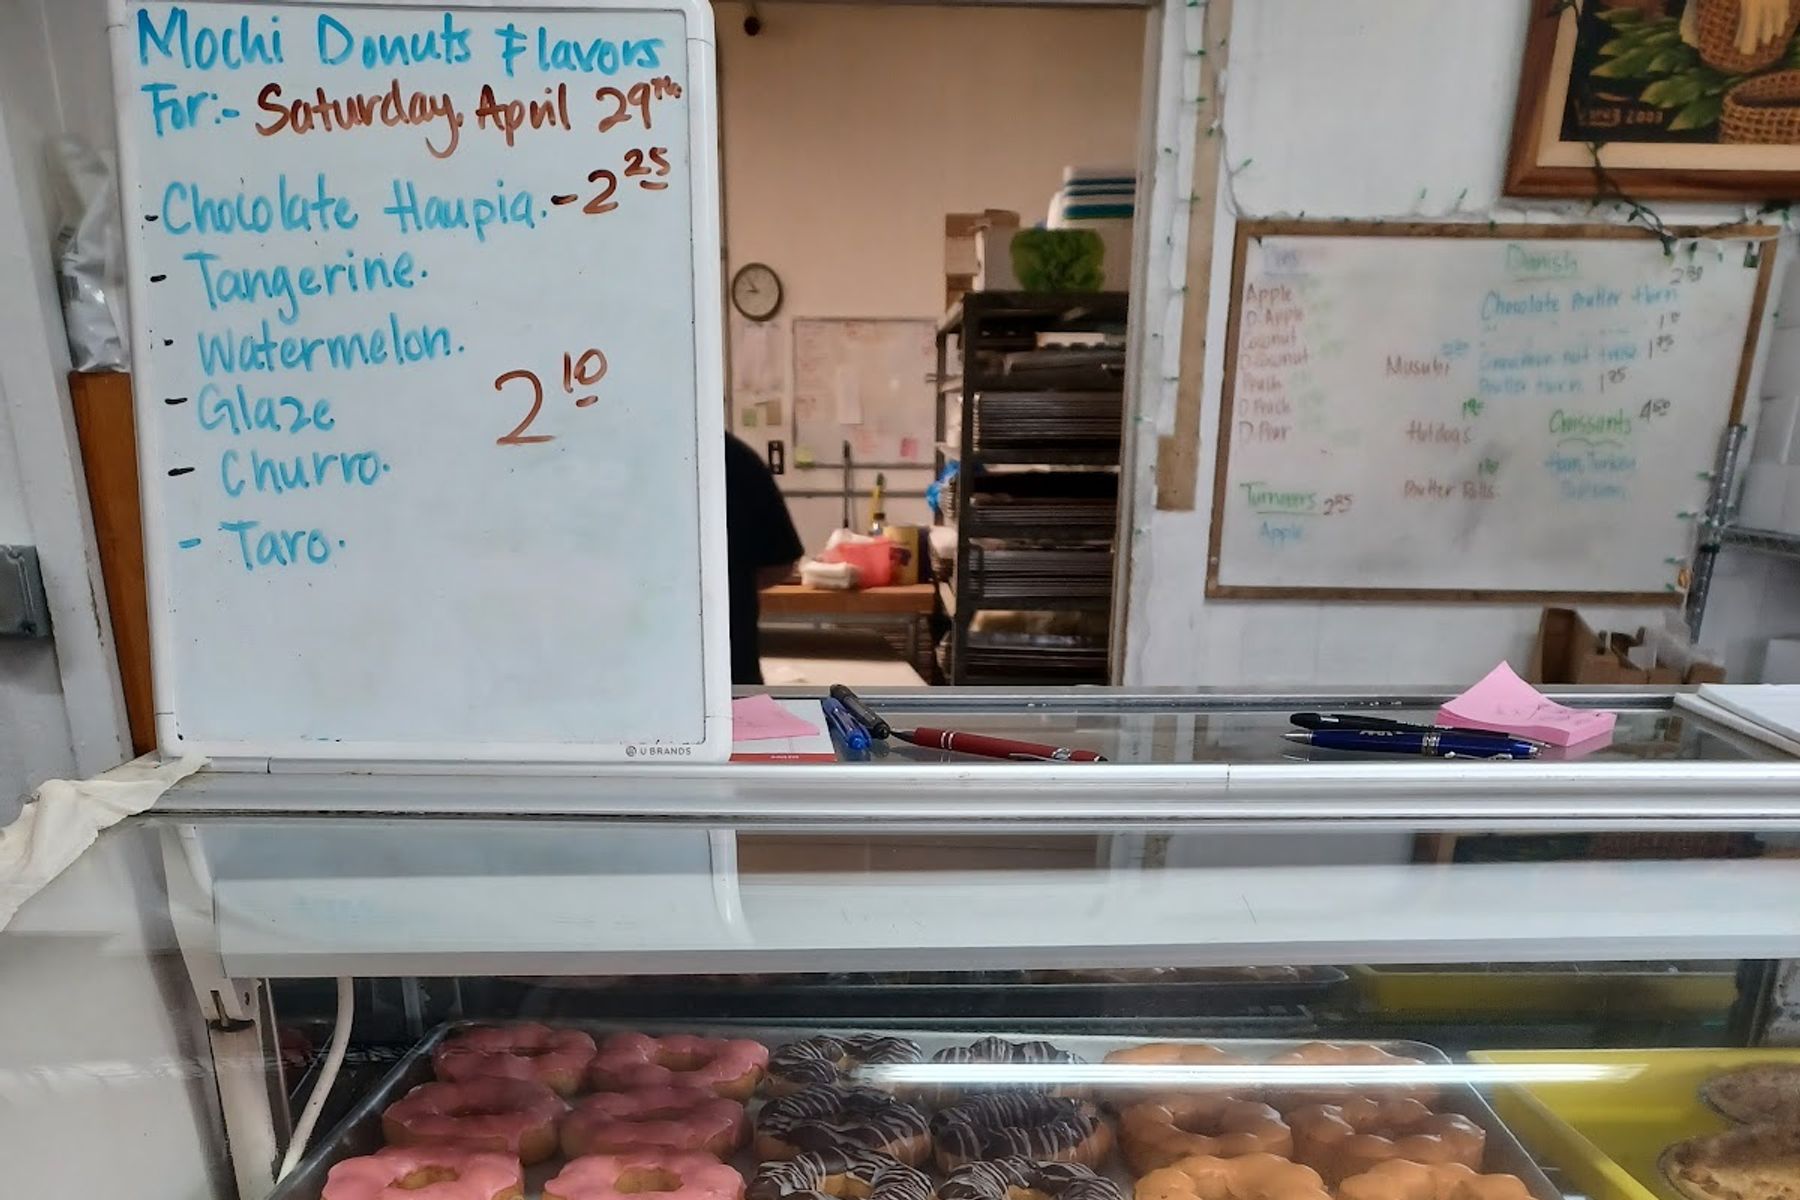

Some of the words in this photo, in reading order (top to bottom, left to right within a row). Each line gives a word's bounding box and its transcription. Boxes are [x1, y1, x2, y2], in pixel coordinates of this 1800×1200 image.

[138, 9, 283, 70] Mochi
[317, 12, 473, 68] Donuts
[494, 23, 667, 77] Flavors
[475, 83, 571, 147] April
[183, 250, 429, 325] Tangerine.
[1245, 282, 1293, 308] Apple
[198, 312, 465, 376] Watermelon.
[198, 386, 336, 436] Glaze
[221, 449, 391, 498] Churro.
[218, 519, 347, 571] Taro.
[649, 746, 692, 756] BRANDS
